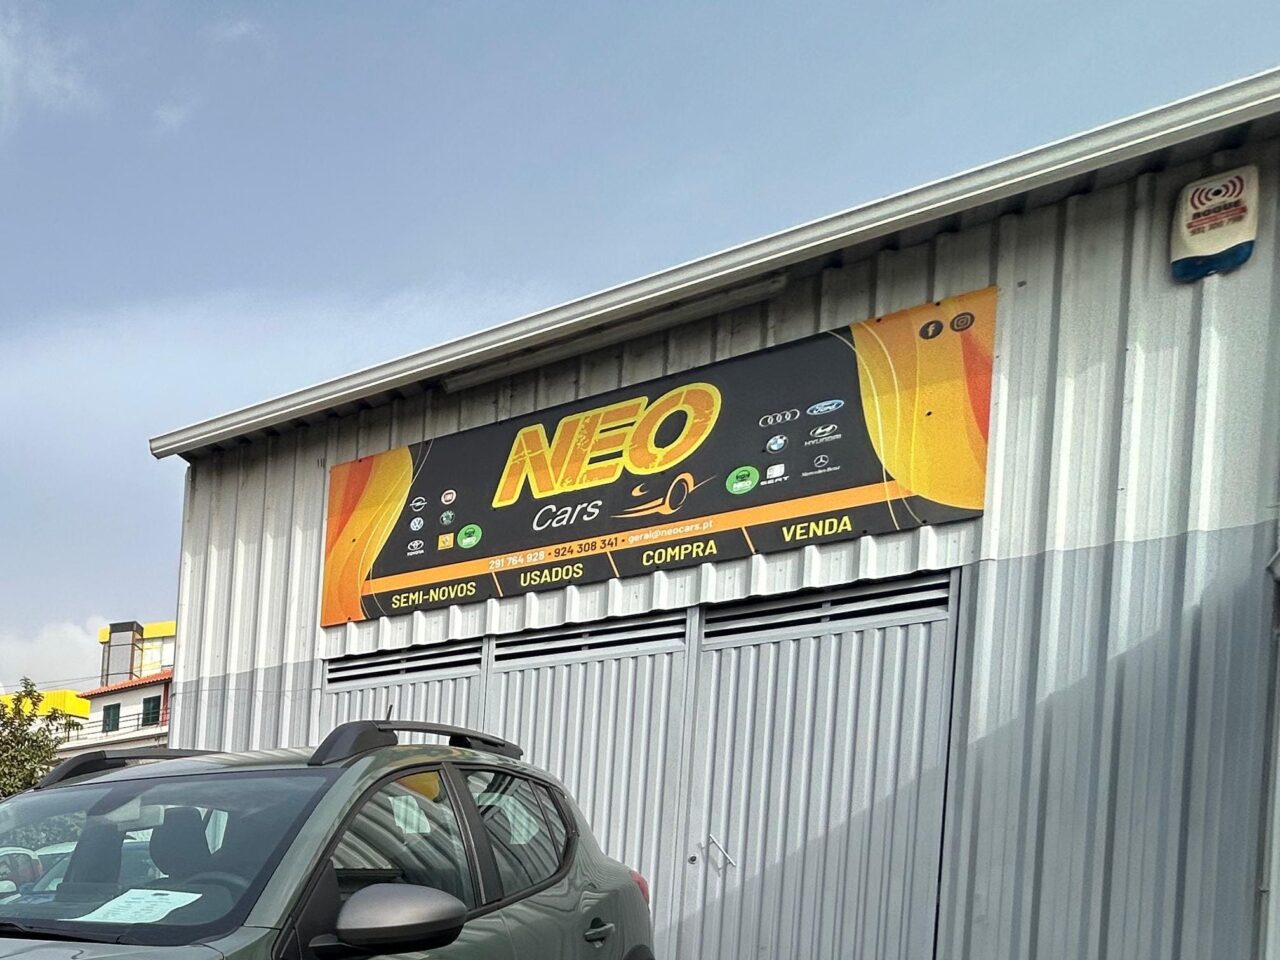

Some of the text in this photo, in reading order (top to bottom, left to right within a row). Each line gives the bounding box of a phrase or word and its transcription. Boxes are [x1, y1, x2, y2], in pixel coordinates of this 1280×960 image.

[491, 382, 722, 508] NEO
[532, 499, 603, 531] Cars
[554, 546, 574, 558] 924
[576, 541, 597, 553] 308
[599, 537, 618, 549] 341
[627, 520, 713, 544] geral@neocars.pt
[391, 515, 853, 609] SEMI-NOVOS USADOS COMPRA VENDA
